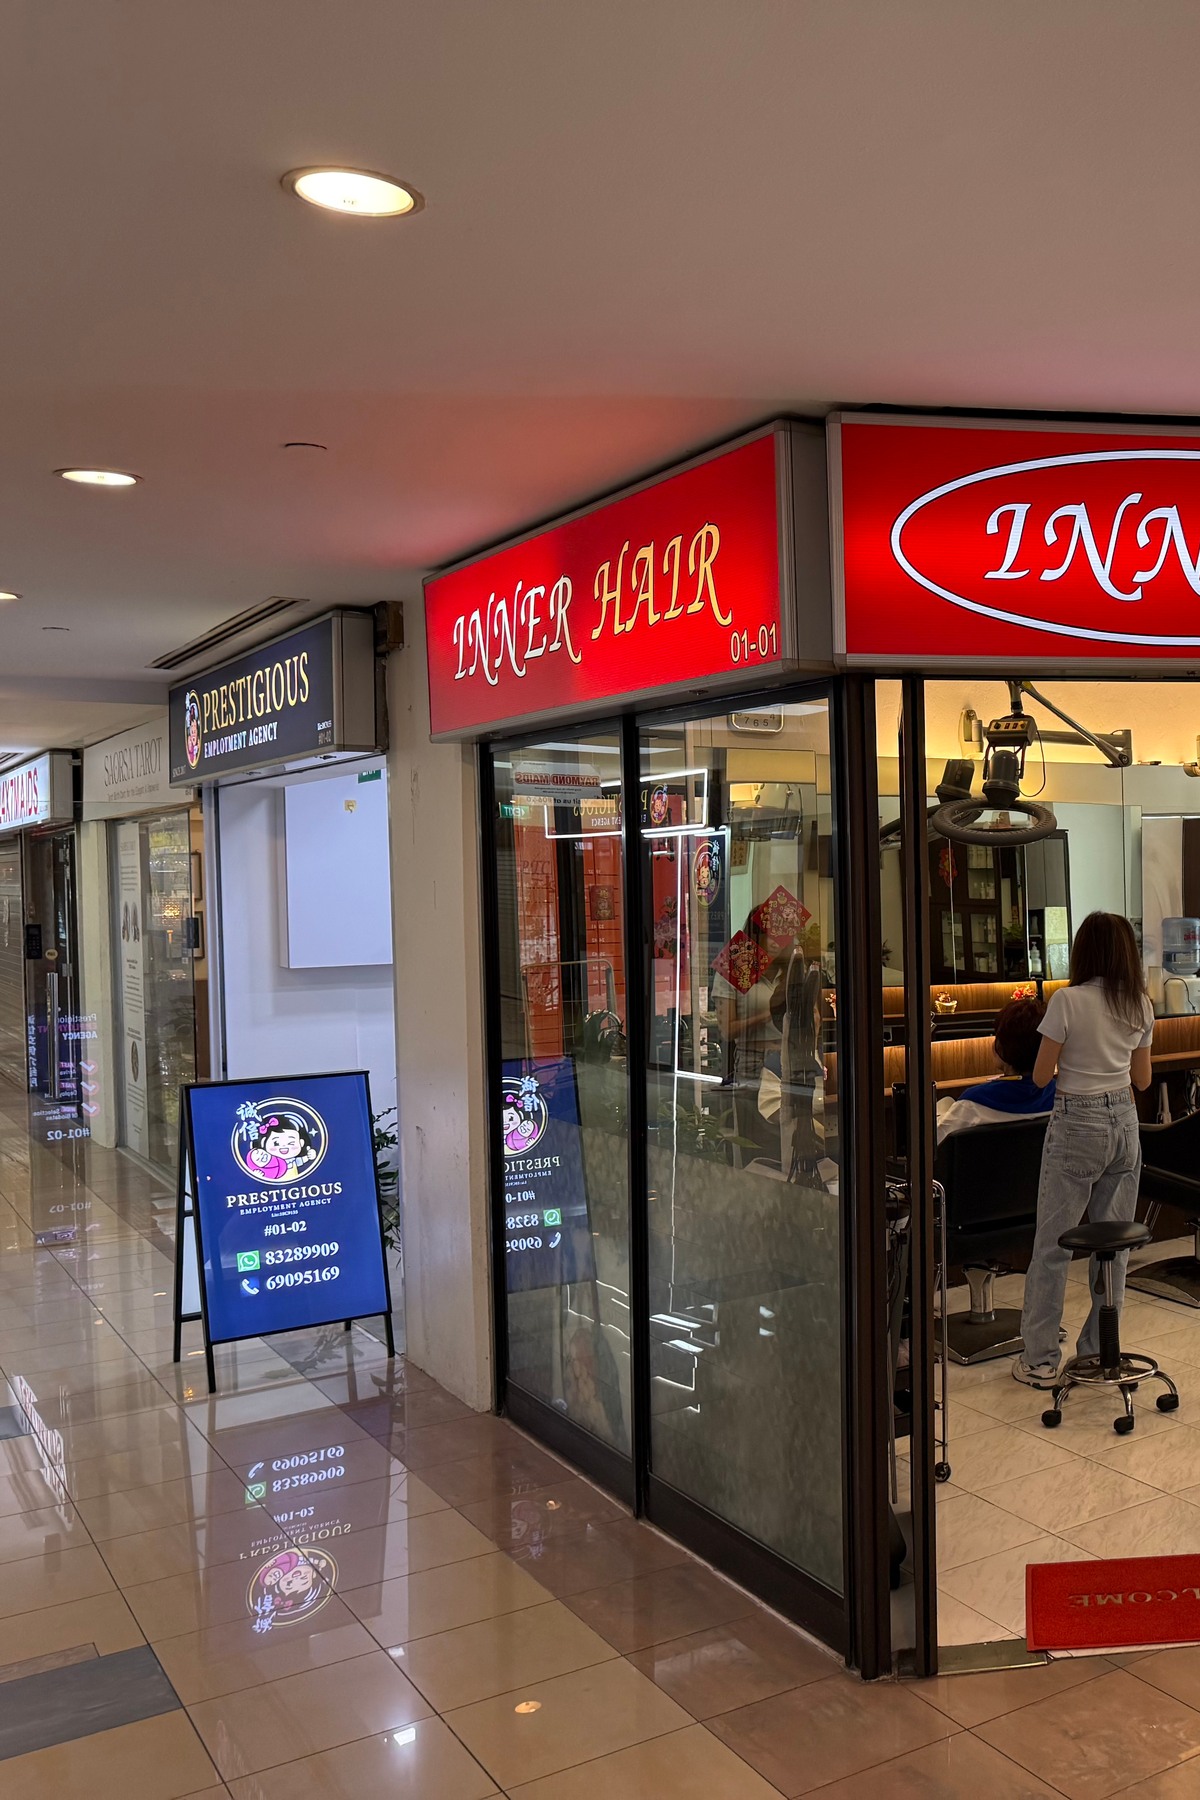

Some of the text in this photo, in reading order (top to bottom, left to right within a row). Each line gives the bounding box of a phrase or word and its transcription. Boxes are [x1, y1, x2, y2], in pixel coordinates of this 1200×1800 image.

[453, 522, 733, 685] INNER HAIR
[729, 622, 777, 663] 01-01
[202, 652, 309, 734] PRESTIGIOUS
[744, 716, 750, 724] 7
[753, 719, 759, 727] 6
[763, 719, 769, 727] 5
[204, 722, 278, 758] EMPLOYMENT AGENCY
[104, 737, 162, 786] SAORSA TAROT
[0, 767, 38, 824] 4X7MAIDS
[236, 1101, 262, 1141] 誠信
[226, 1182, 343, 1208] PRESTIGIOUS
[240, 1197, 332, 1216] EMPLOYMENT AGENCY
[264, 1221, 307, 1236] #01-02
[265, 1241, 339, 1265] 83289909
[266, 1266, 340, 1290] 69095169
